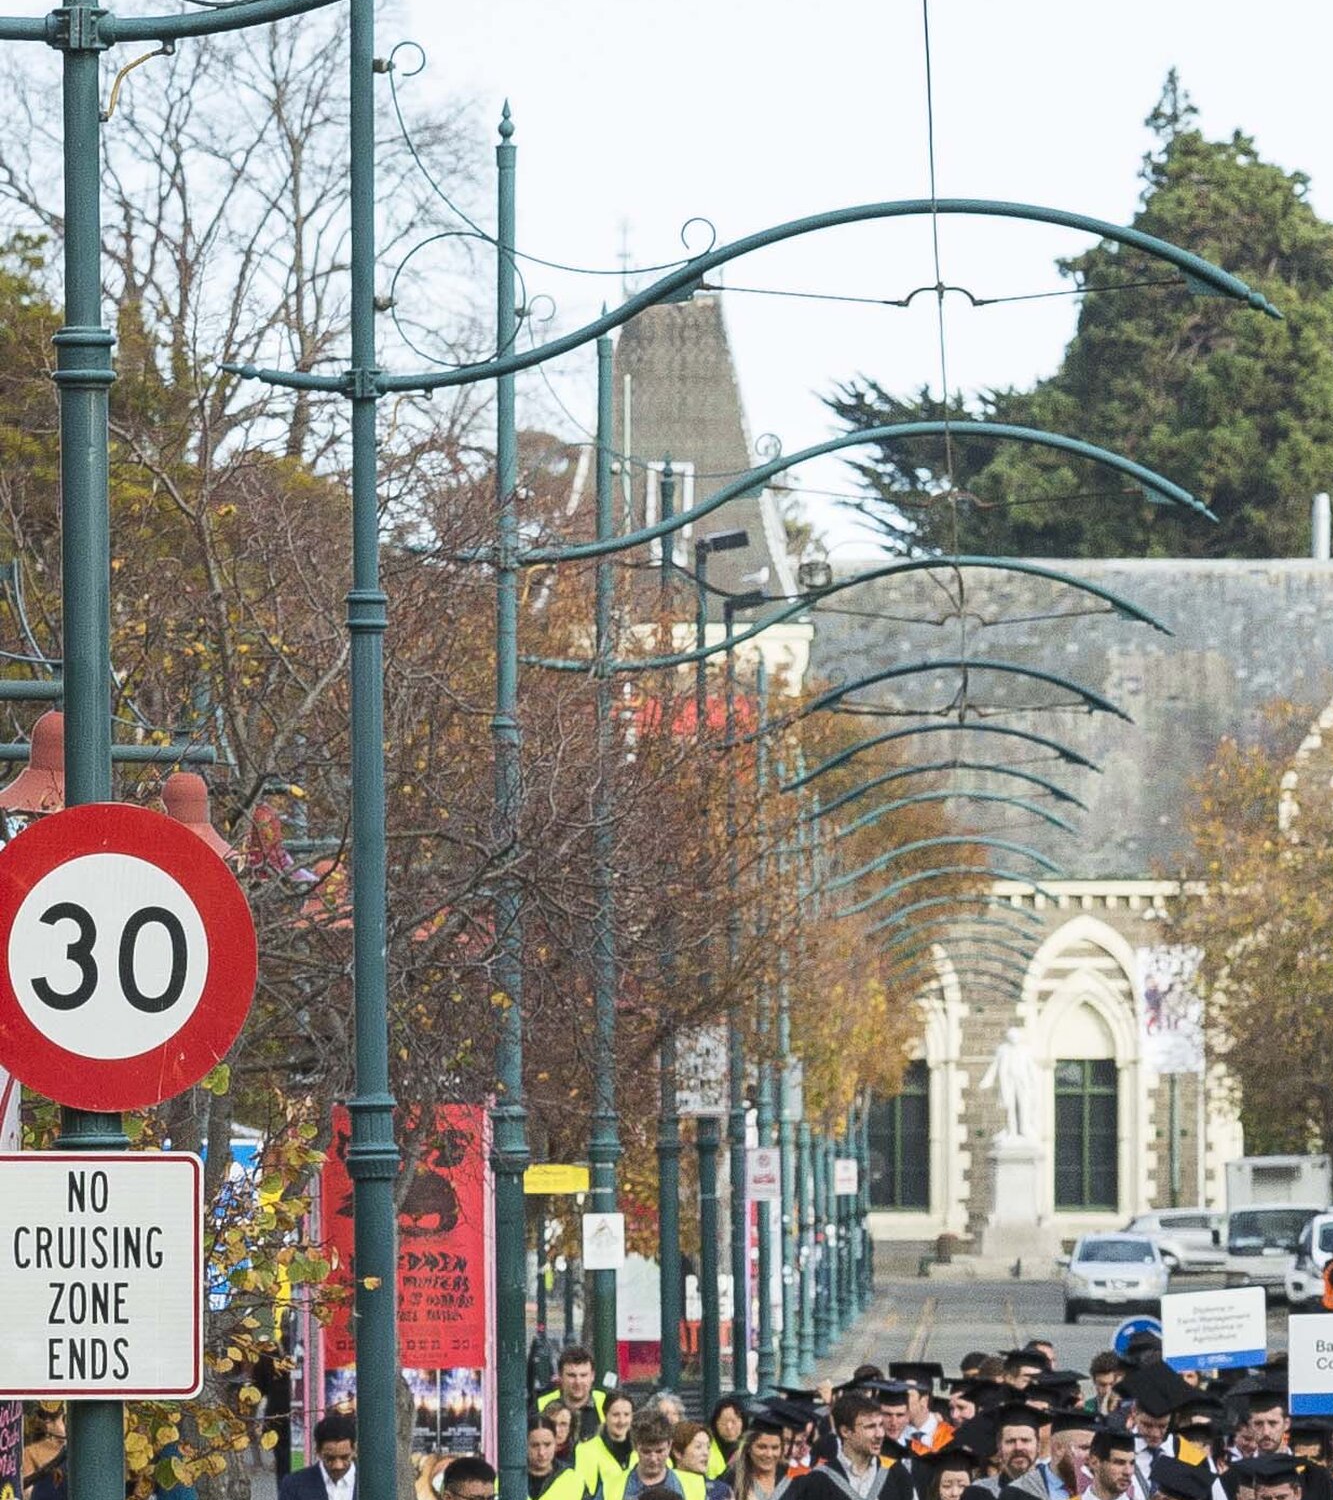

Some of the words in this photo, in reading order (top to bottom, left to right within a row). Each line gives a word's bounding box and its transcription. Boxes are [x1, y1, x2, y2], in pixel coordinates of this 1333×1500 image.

[30, 901, 189, 1014] 30
[67, 1170, 109, 1214] NO
[13, 1226, 165, 1270] CRUISING
[48, 1282, 130, 1326] ZONE
[48, 1337, 131, 1381] ENDS
